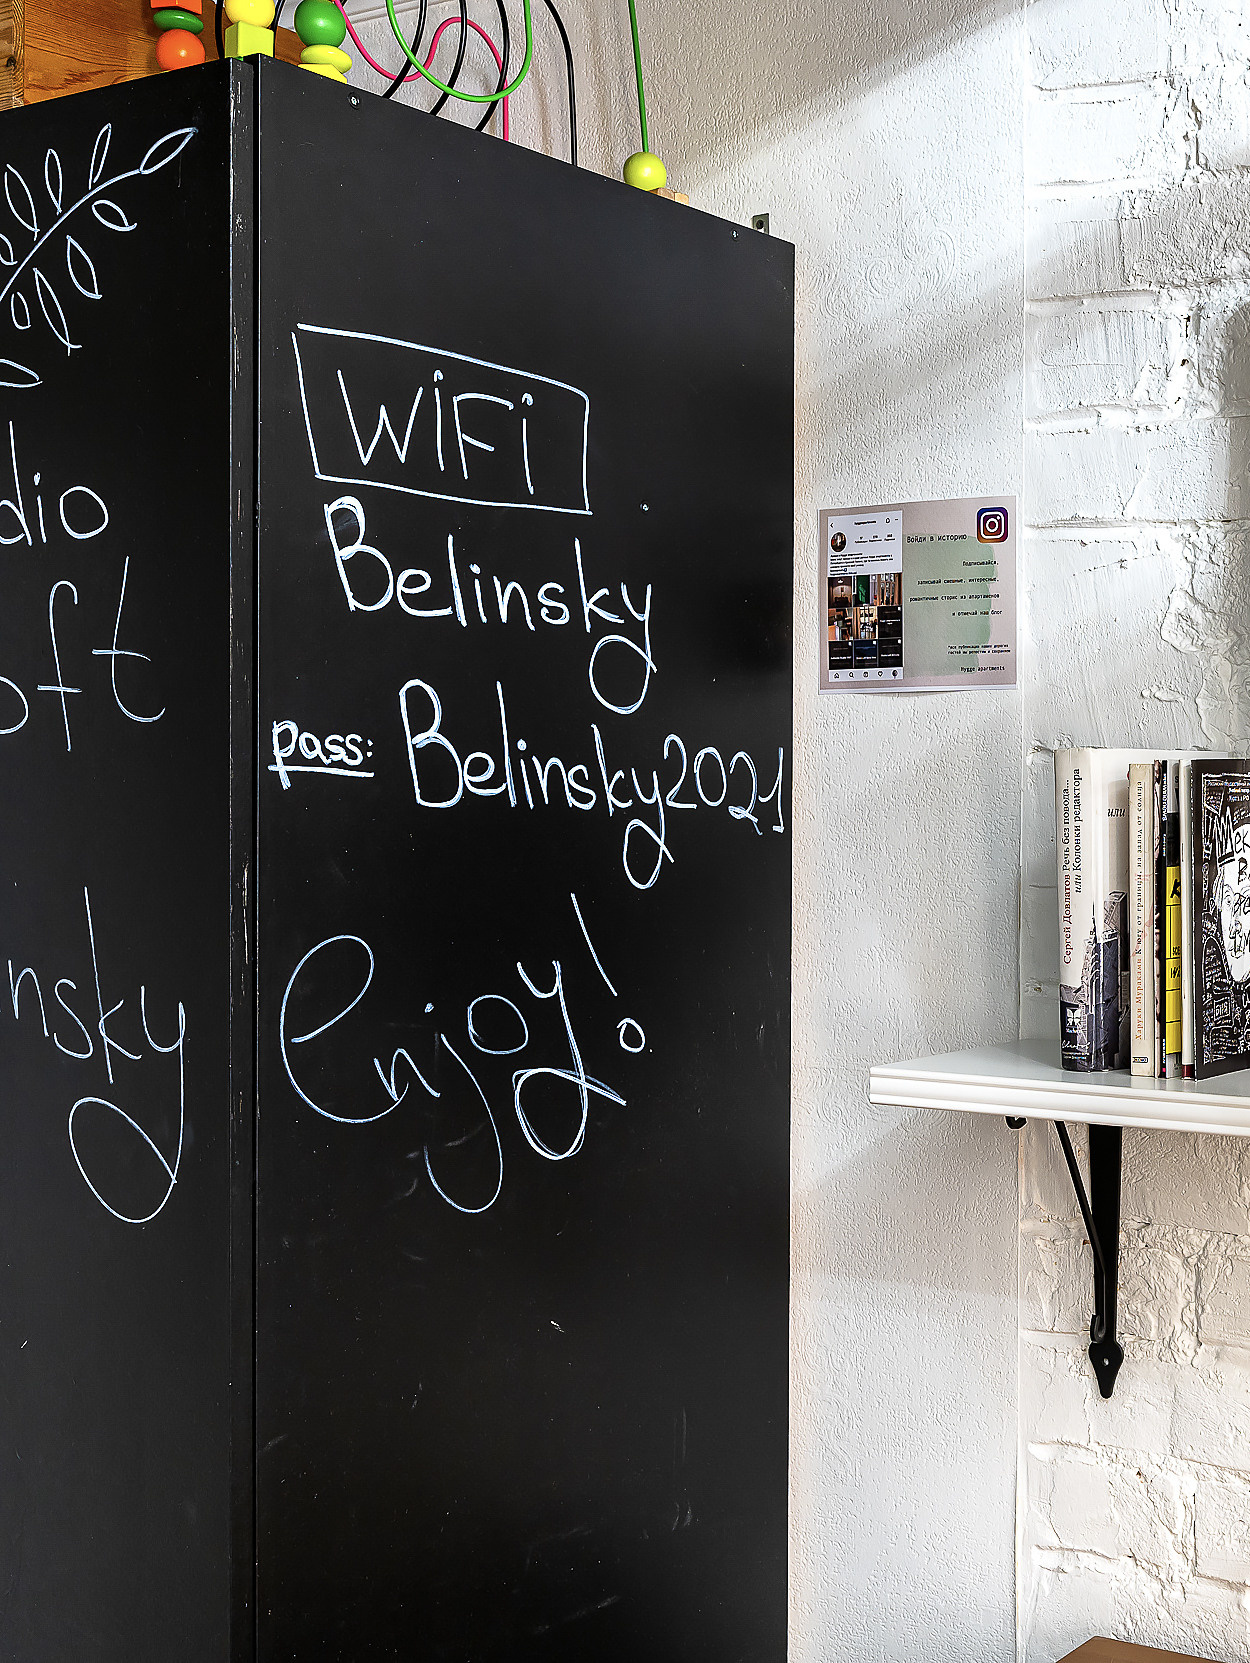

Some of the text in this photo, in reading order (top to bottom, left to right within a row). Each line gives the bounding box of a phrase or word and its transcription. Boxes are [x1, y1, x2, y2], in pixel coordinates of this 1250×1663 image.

[906, 535, 926, 543] Войди
[324, 495, 657, 714] Belinsky
[271, 679, 785, 889] pass: Belinsky2021
[1136, 781, 1144, 812] солнца
[1107, 807, 1126, 818] или
[1137, 817, 1142, 825] от
[1072, 768, 1083, 894] или Колонки редактора
[1136, 829, 1144, 853] запад
[1062, 779, 1074, 965] Сергей Довлатов Речь без повода...
[1137, 857, 1142, 867] на
[1136, 934, 1144, 947] югу
[1135, 958, 1144, 1004] Мураками
[1135, 1010, 1144, 1040] Харуки
